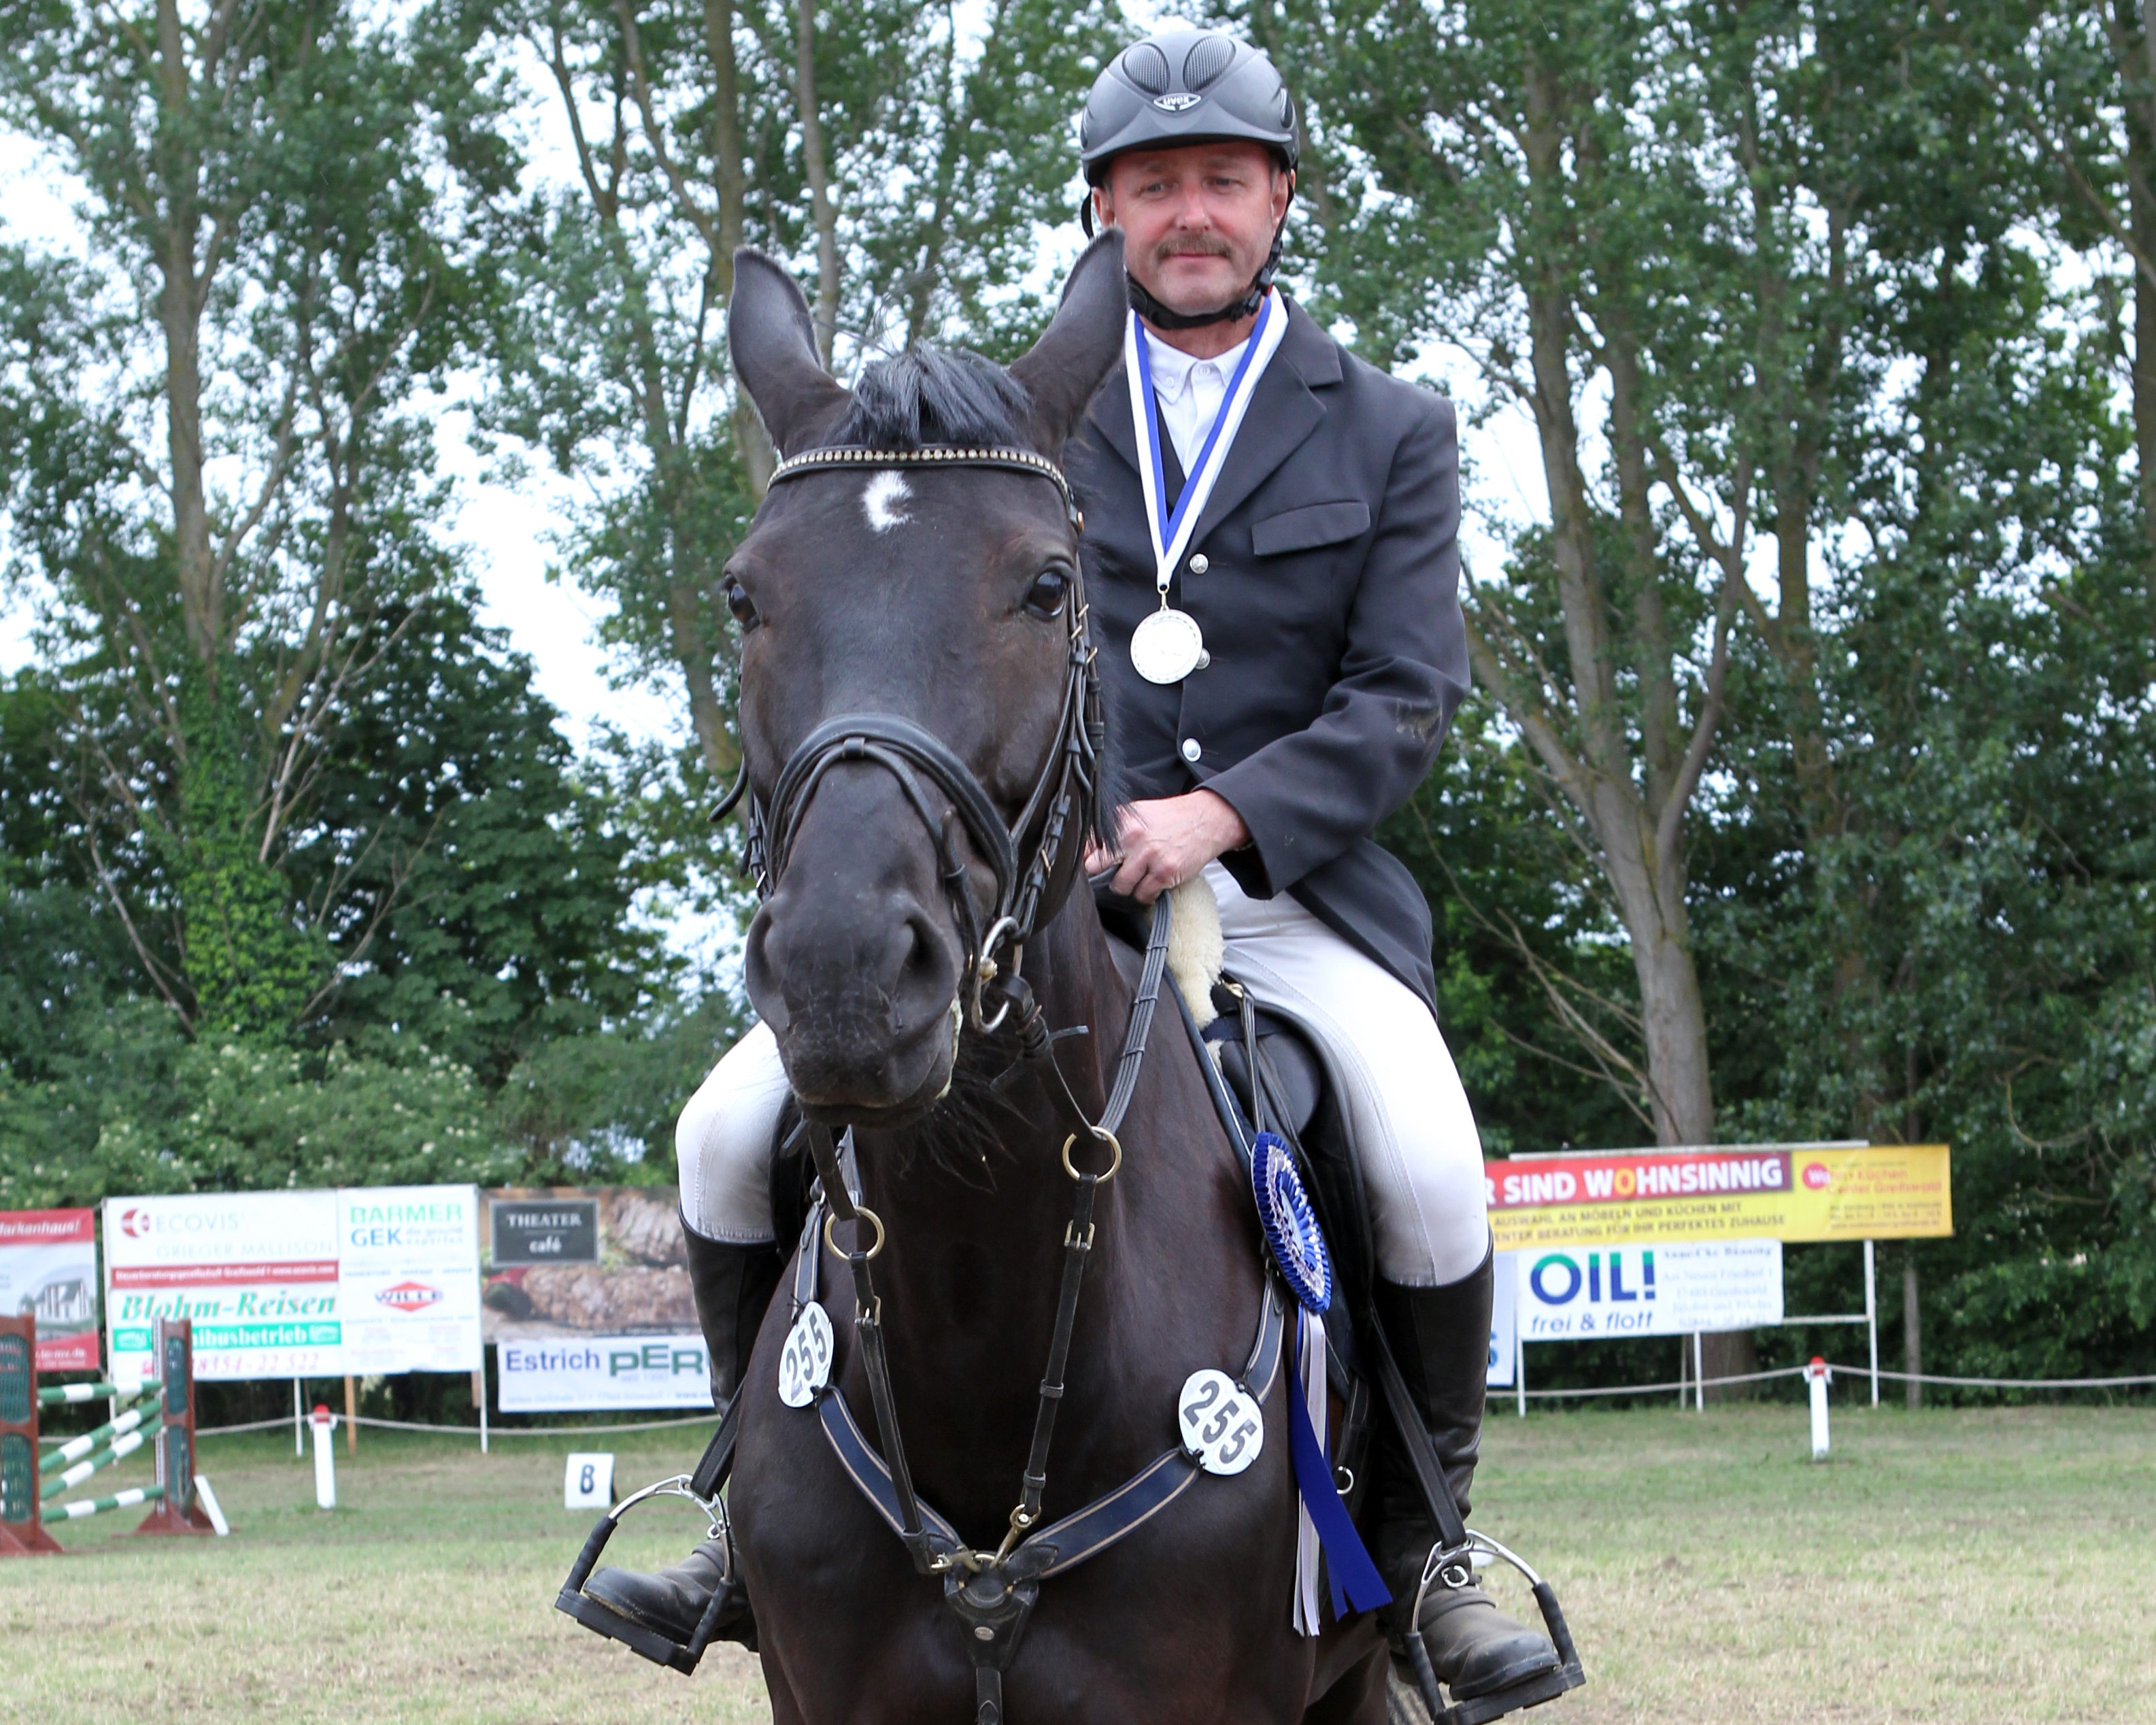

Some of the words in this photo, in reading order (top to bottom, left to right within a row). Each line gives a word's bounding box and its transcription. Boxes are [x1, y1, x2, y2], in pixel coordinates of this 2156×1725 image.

[1504, 1172, 1576, 1204] SIND
[1583, 1158, 1783, 1199] WOHNSINNIG
[156, 1212, 239, 1234] ECOVIS
[350, 1203, 462, 1224] BARMER
[506, 1213, 583, 1228] THEATER
[1495, 1213, 1553, 1227] AUSWAHL
[1560, 1211, 1577, 1223] AN
[1581, 1207, 1632, 1222] MÖBELN
[1636, 1205, 1662, 1218] UND
[1666, 1202, 1715, 1216] KÜCHEN
[1721, 1201, 1742, 1213] MIT
[350, 1227, 403, 1247] GEK
[1538, 1226, 1602, 1241] BERATUNG
[1607, 1222, 1630, 1237] FÜR
[1634, 1222, 1655, 1234] IHR
[1658, 1218, 1725, 1233] PERFEKTES
[1730, 1214, 1785, 1228] ZUHAUSE
[529, 1235, 562, 1253] café
[1530, 1250, 1656, 1305] OIL!
[122, 1290, 337, 1320] Blohm-Reisen
[1532, 1313, 1572, 1333] frei
[1580, 1311, 1595, 1332] &
[1606, 1310, 1653, 1330] flott
[506, 1347, 601, 1371] Estrich
[786, 1309, 827, 1403] 255
[1183, 1379, 1258, 1464] 255
